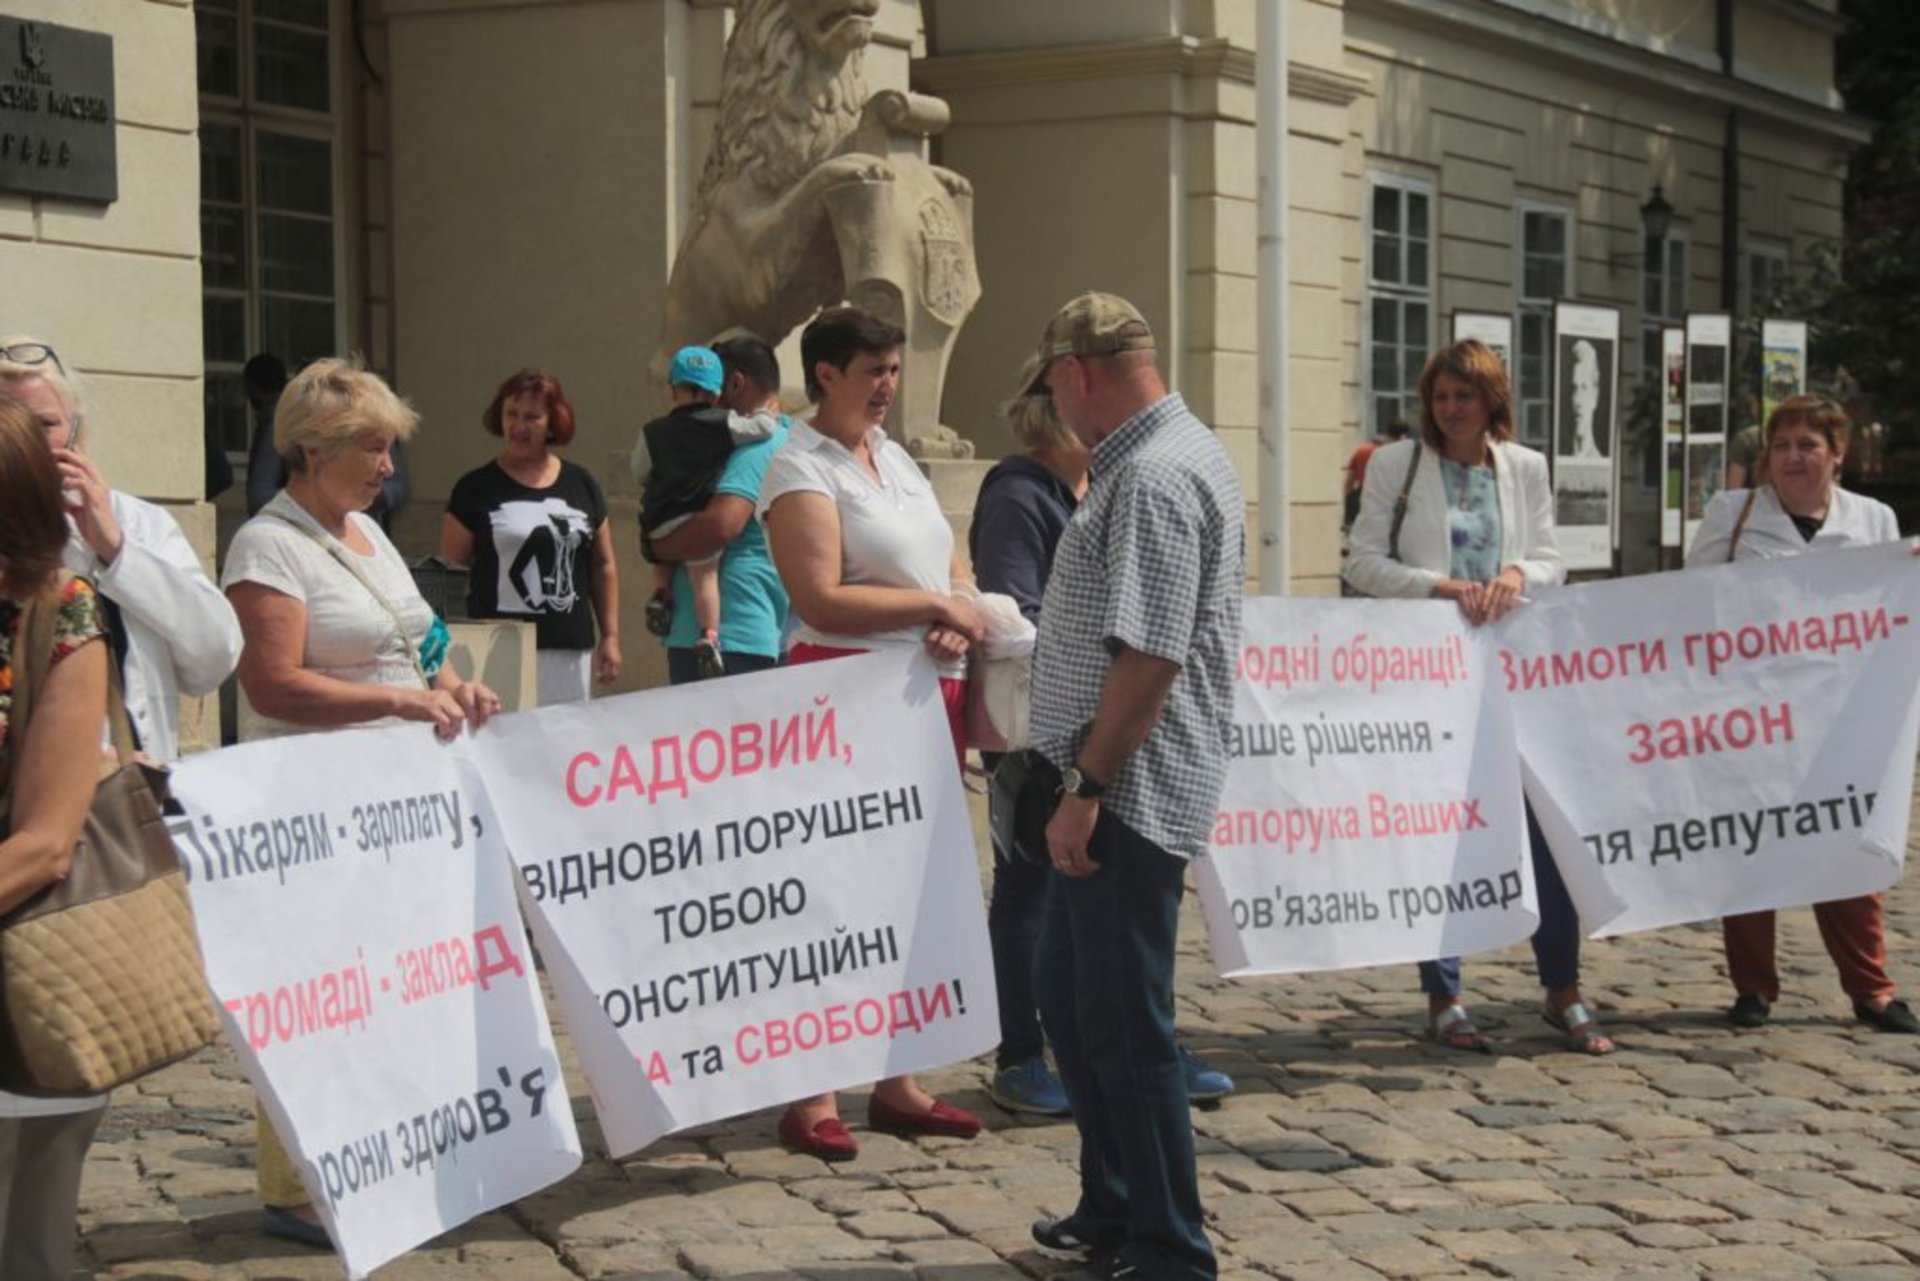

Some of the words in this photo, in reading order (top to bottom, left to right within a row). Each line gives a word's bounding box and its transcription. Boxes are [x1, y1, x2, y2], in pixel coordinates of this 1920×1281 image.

[1235, 633, 1320, 690] одні
[1332, 634, 1469, 693] обранці!
[1683, 607, 1910, 676] громади-
[565, 696, 853, 806] САДОВИЙ,
[1231, 723, 1296, 758] аше
[1303, 711, 1433, 767] рішення
[1626, 701, 1796, 764] закон
[352, 789, 483, 864] зарплату,
[521, 828, 703, 905] ВІДНОВИ
[717, 785, 924, 859] ПОРУШЕНІ
[1208, 805, 1362, 854] апорука
[1367, 793, 1490, 838] Ваших
[654, 877, 806, 944] ТОБОЮ
[1231, 884, 1380, 931] ов'язань
[395, 923, 525, 1005] заклад
[597, 924, 900, 1029] ОНСТИТУЦІЙНІ
[681, 1044, 724, 1079] та
[735, 978, 968, 1066] СВОБОДИ!
[316, 1130, 394, 1219] рони
